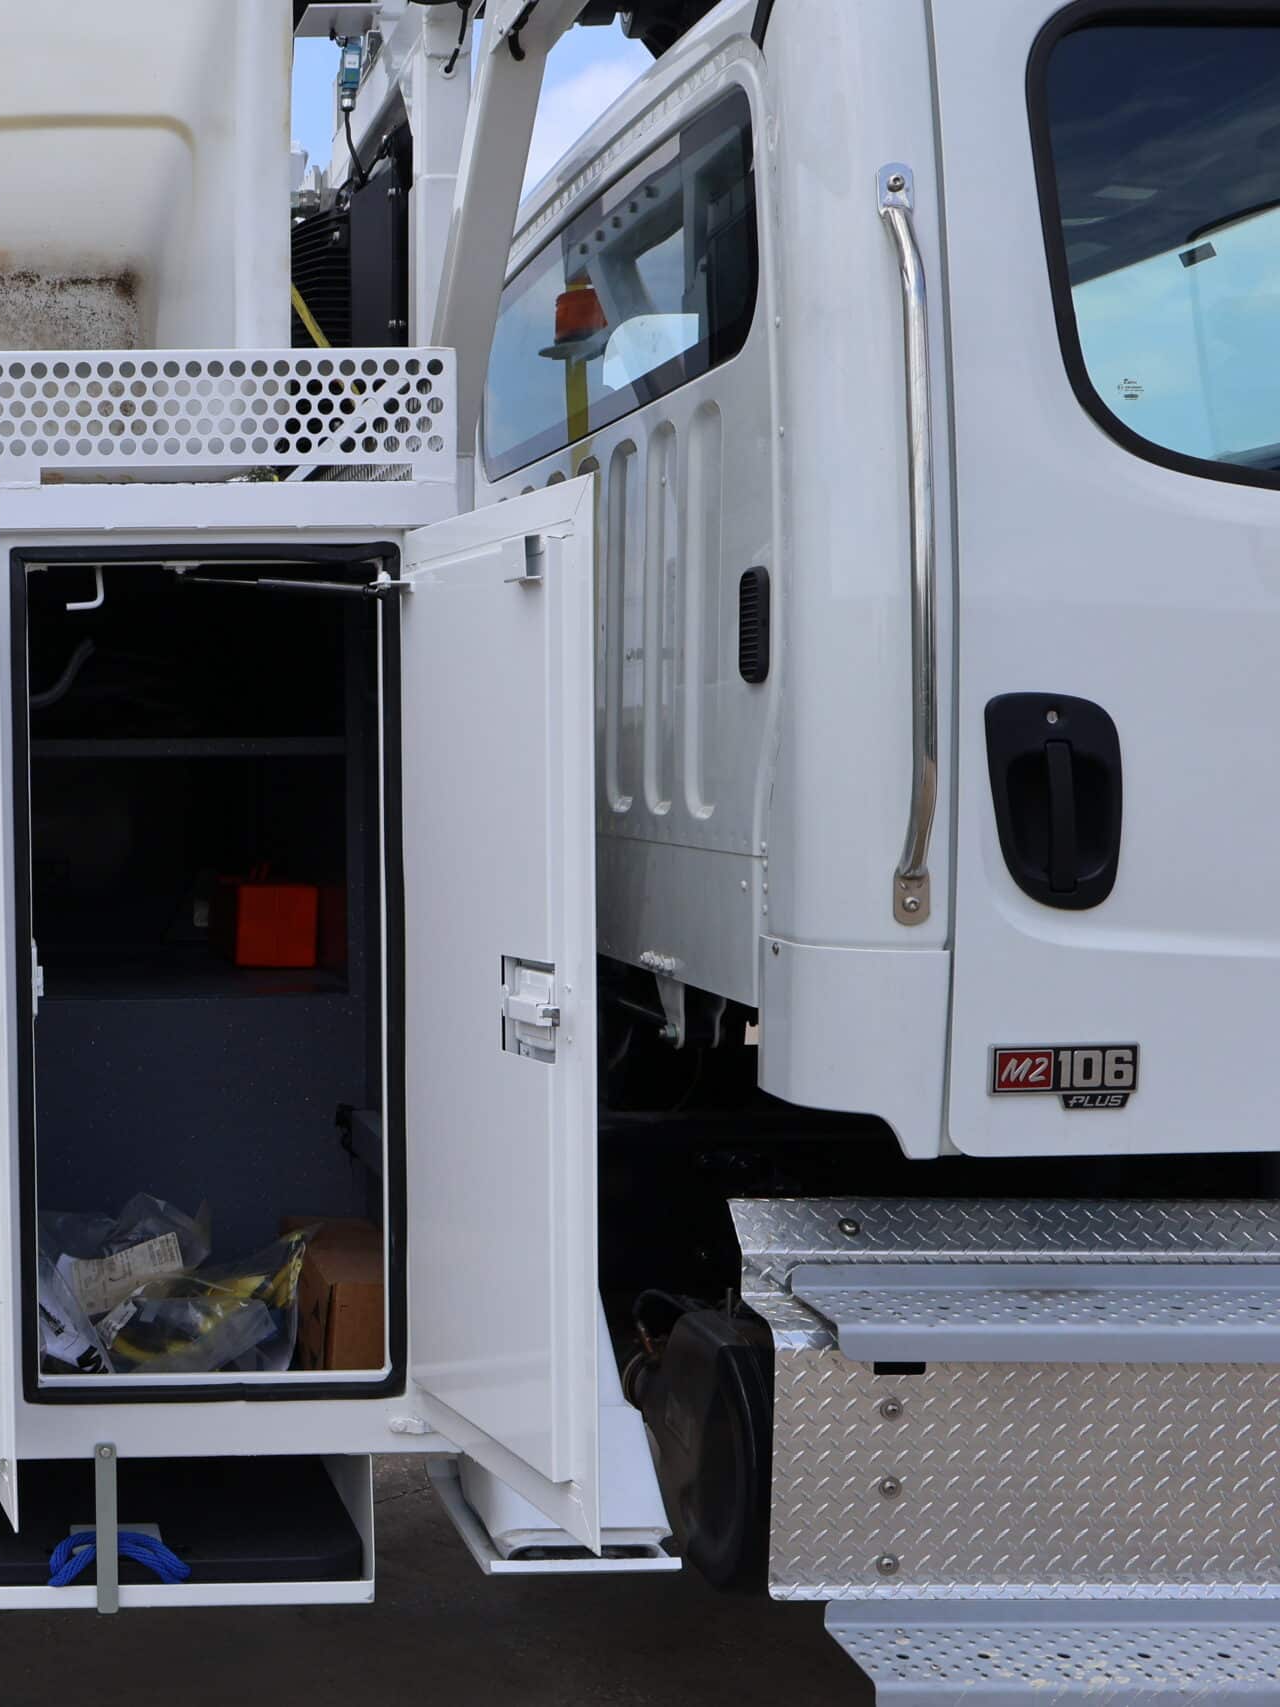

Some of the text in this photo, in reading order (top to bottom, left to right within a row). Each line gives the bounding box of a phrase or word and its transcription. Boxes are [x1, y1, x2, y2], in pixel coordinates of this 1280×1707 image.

[1000, 1049, 1134, 1089] M2 106
[1068, 1095, 1124, 1107] PLUS
